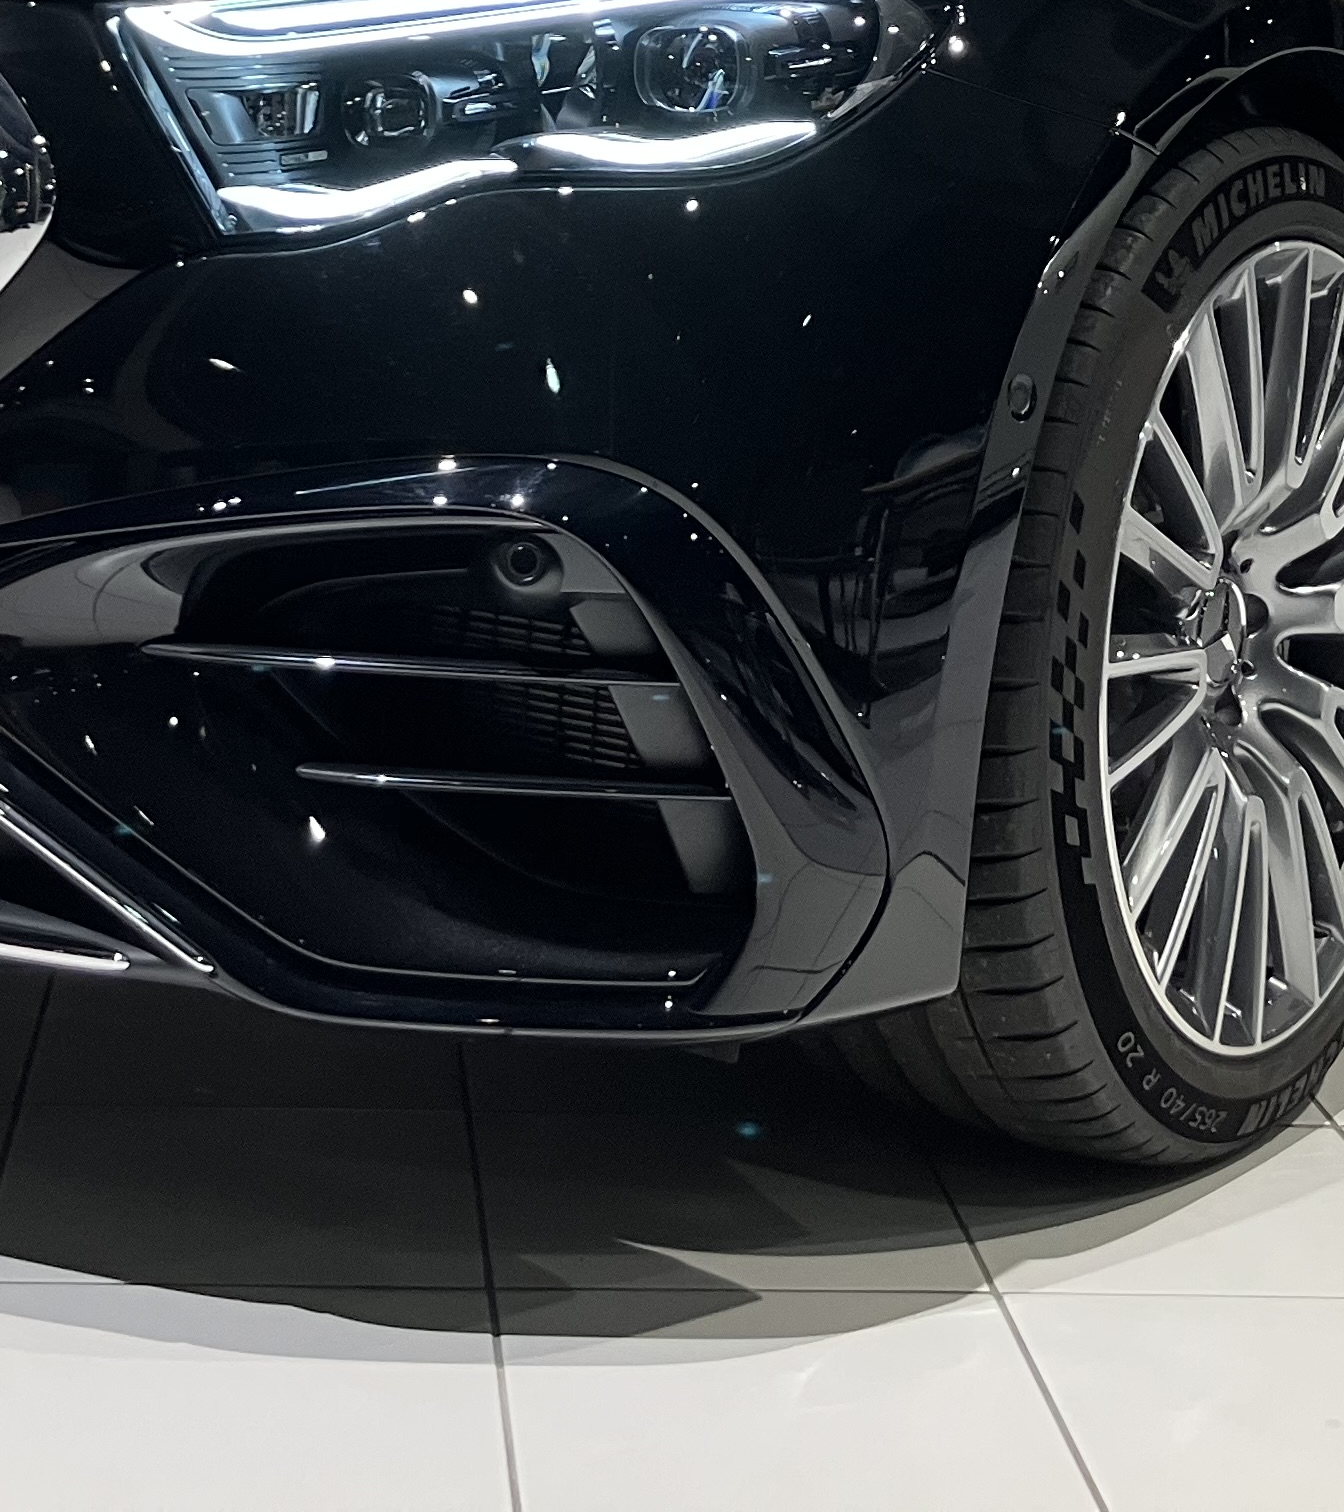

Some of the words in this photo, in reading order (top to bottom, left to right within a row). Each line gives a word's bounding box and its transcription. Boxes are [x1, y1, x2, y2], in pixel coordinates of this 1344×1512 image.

[1191, 161, 1326, 257] MICHELIN
[1117, 1031, 1145, 1068] 20
[1142, 1068, 1163, 1091] R
[1159, 1088, 1229, 1133] 265/40
